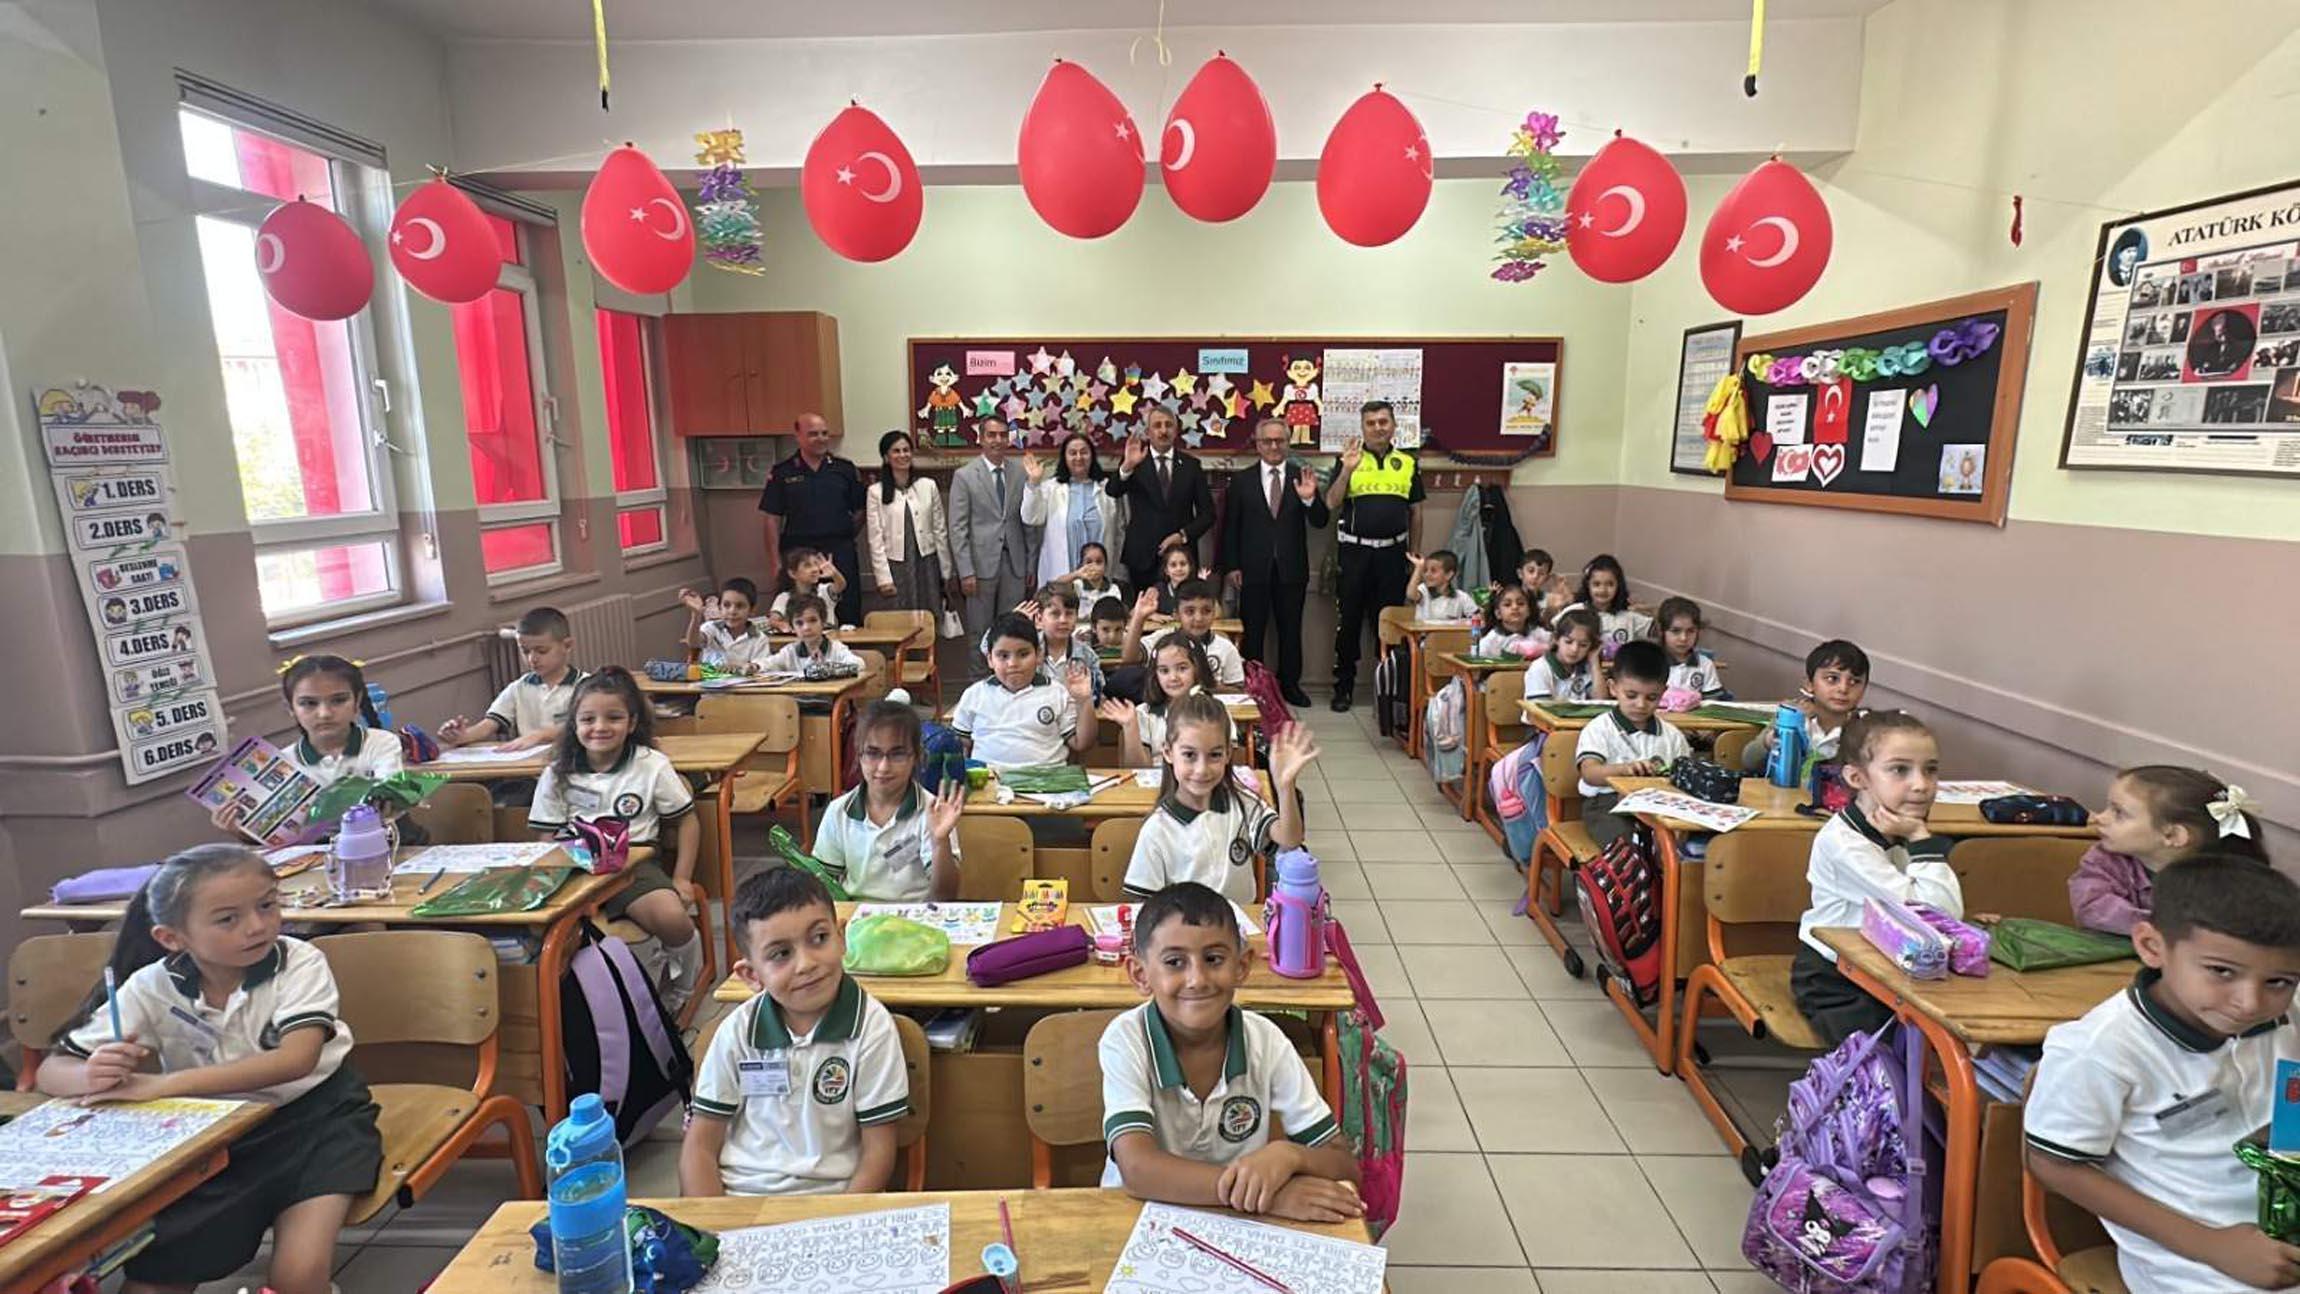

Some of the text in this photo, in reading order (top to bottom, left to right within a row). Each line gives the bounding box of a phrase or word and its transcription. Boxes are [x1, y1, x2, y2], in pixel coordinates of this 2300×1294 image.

[2168, 213, 2264, 247] ATATÜRK
[969, 356, 997, 368] Bizim
[116, 479, 156, 497] DERS
[171, 702, 207, 725] DERS
